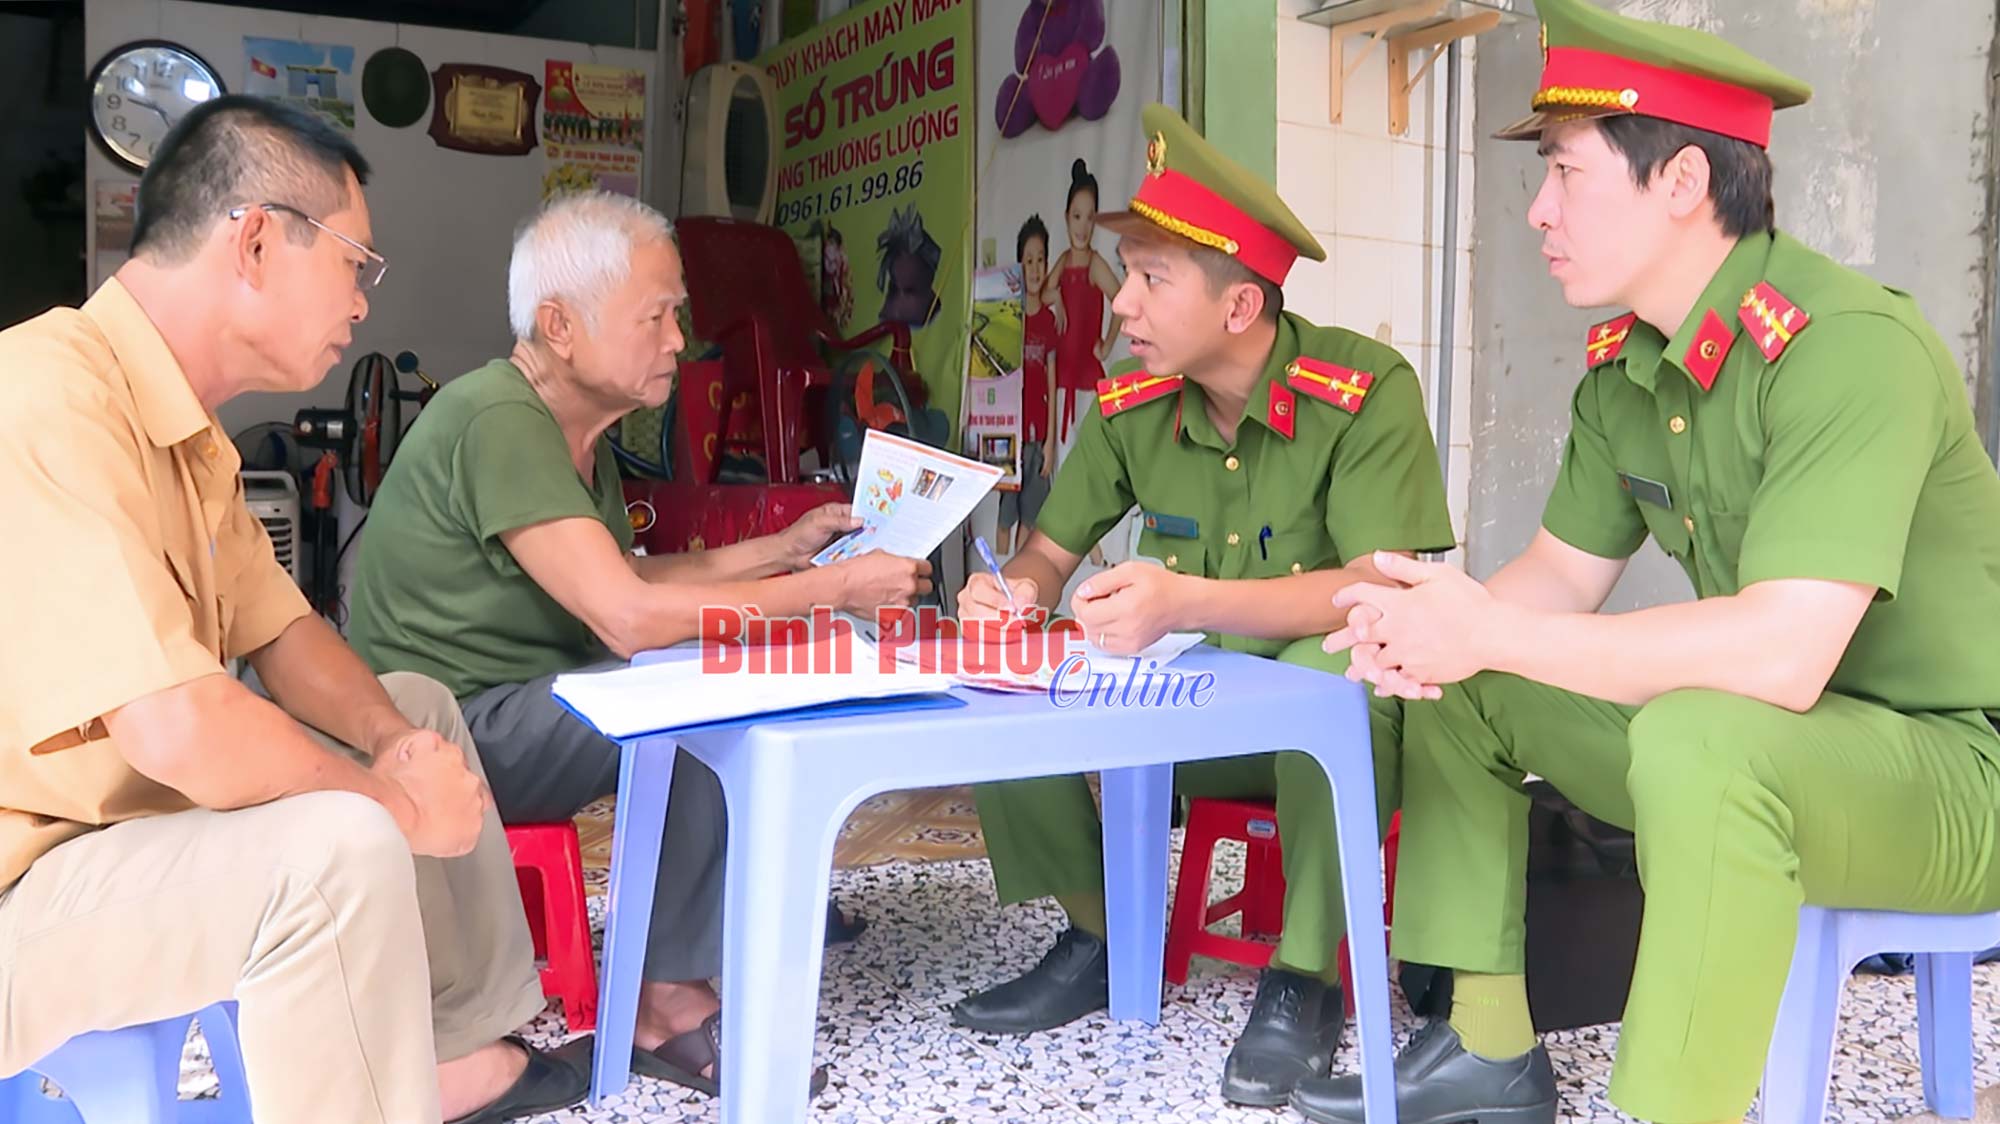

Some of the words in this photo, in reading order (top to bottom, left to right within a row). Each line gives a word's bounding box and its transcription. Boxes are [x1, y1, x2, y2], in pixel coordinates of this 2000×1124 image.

[864, 0, 907, 48] MAY
[107, 94, 121, 110] 9
[784, 75, 828, 149] SỐ
[831, 37, 955, 128] TRÚNG
[112, 115, 126, 131] 8
[128, 132, 141, 148] 7
[886, 103, 959, 157] LƯỢNG
[777, 160, 924, 227] 0961.61.99.86
